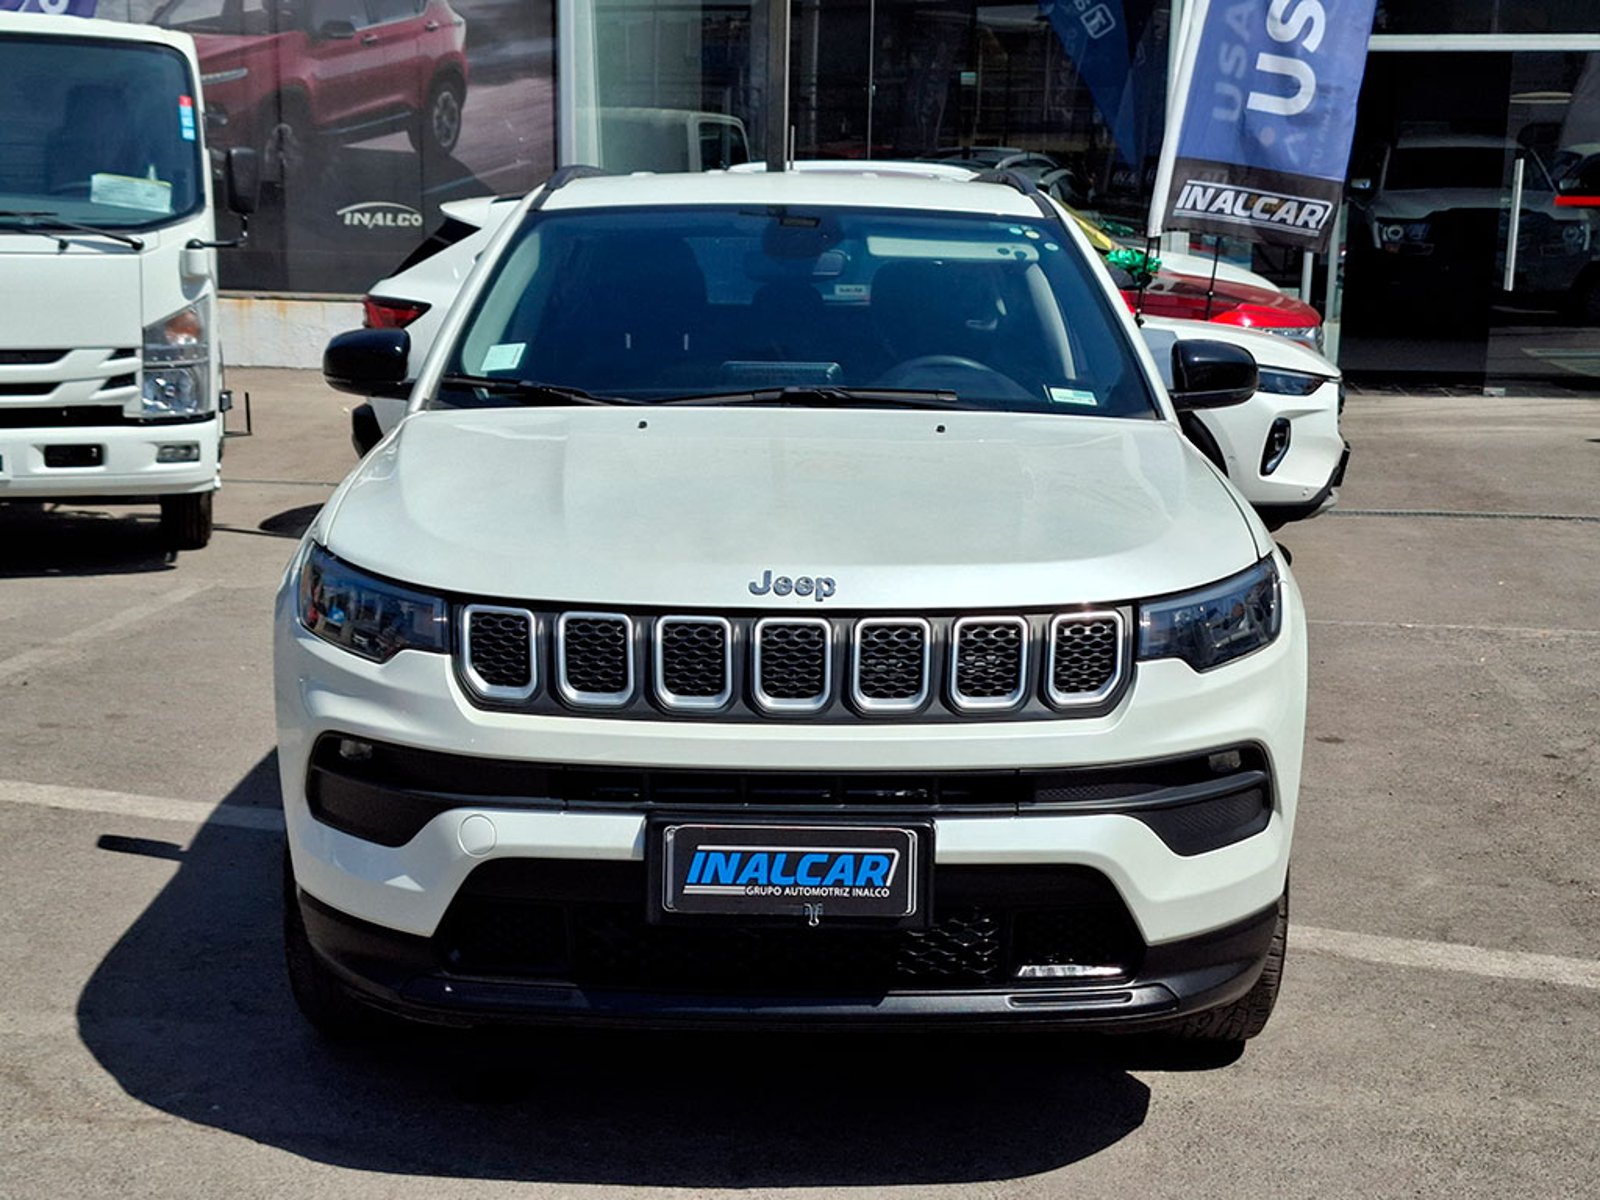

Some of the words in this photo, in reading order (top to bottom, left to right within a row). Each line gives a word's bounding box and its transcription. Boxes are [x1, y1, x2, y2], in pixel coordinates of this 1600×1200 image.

[343, 211, 423, 229] INALCO
[1175, 184, 1326, 230] INALCAR
[748, 570, 836, 602] Jeep
[685, 851, 892, 887] INALCAR
[746, 886, 782, 896] GRUPO
[784, 887, 850, 898] AUTOMOTRIZ
[852, 888, 890, 898] INALCO
